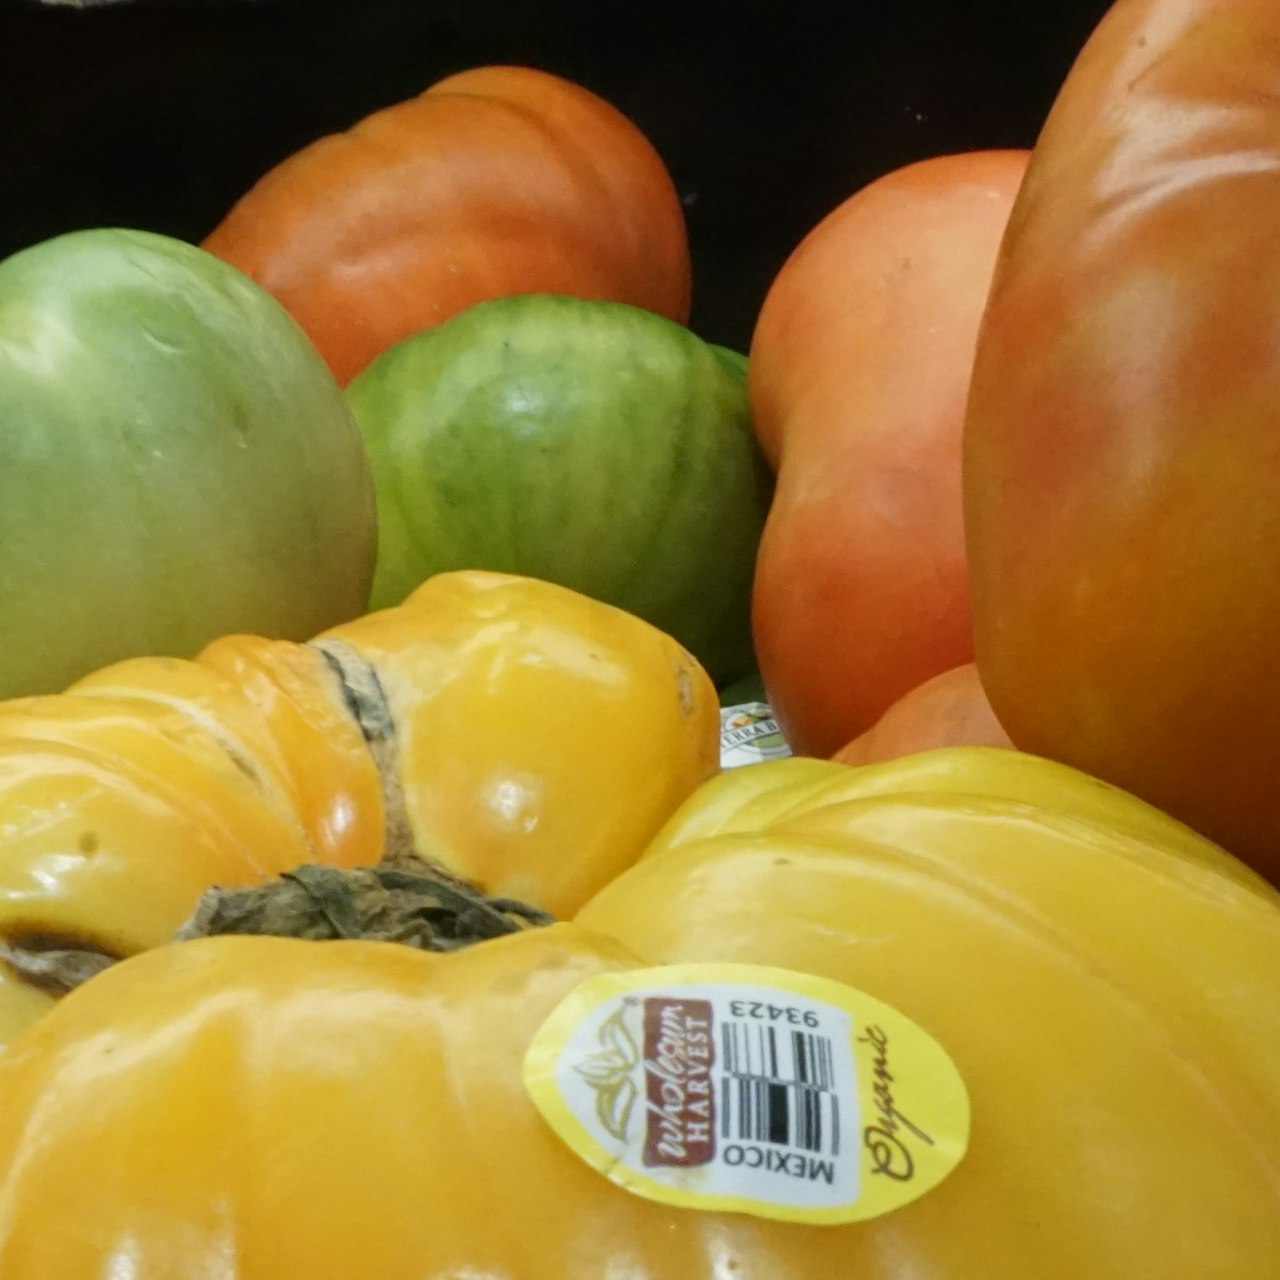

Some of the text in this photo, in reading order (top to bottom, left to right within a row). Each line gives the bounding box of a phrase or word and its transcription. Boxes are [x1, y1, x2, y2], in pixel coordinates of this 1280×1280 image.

[729, 1000, 820, 1028] 93423
[686, 1016, 710, 1143] HARVEST
[858, 1024, 935, 1182] Organic
[724, 1144, 834, 1185] MEXICO
